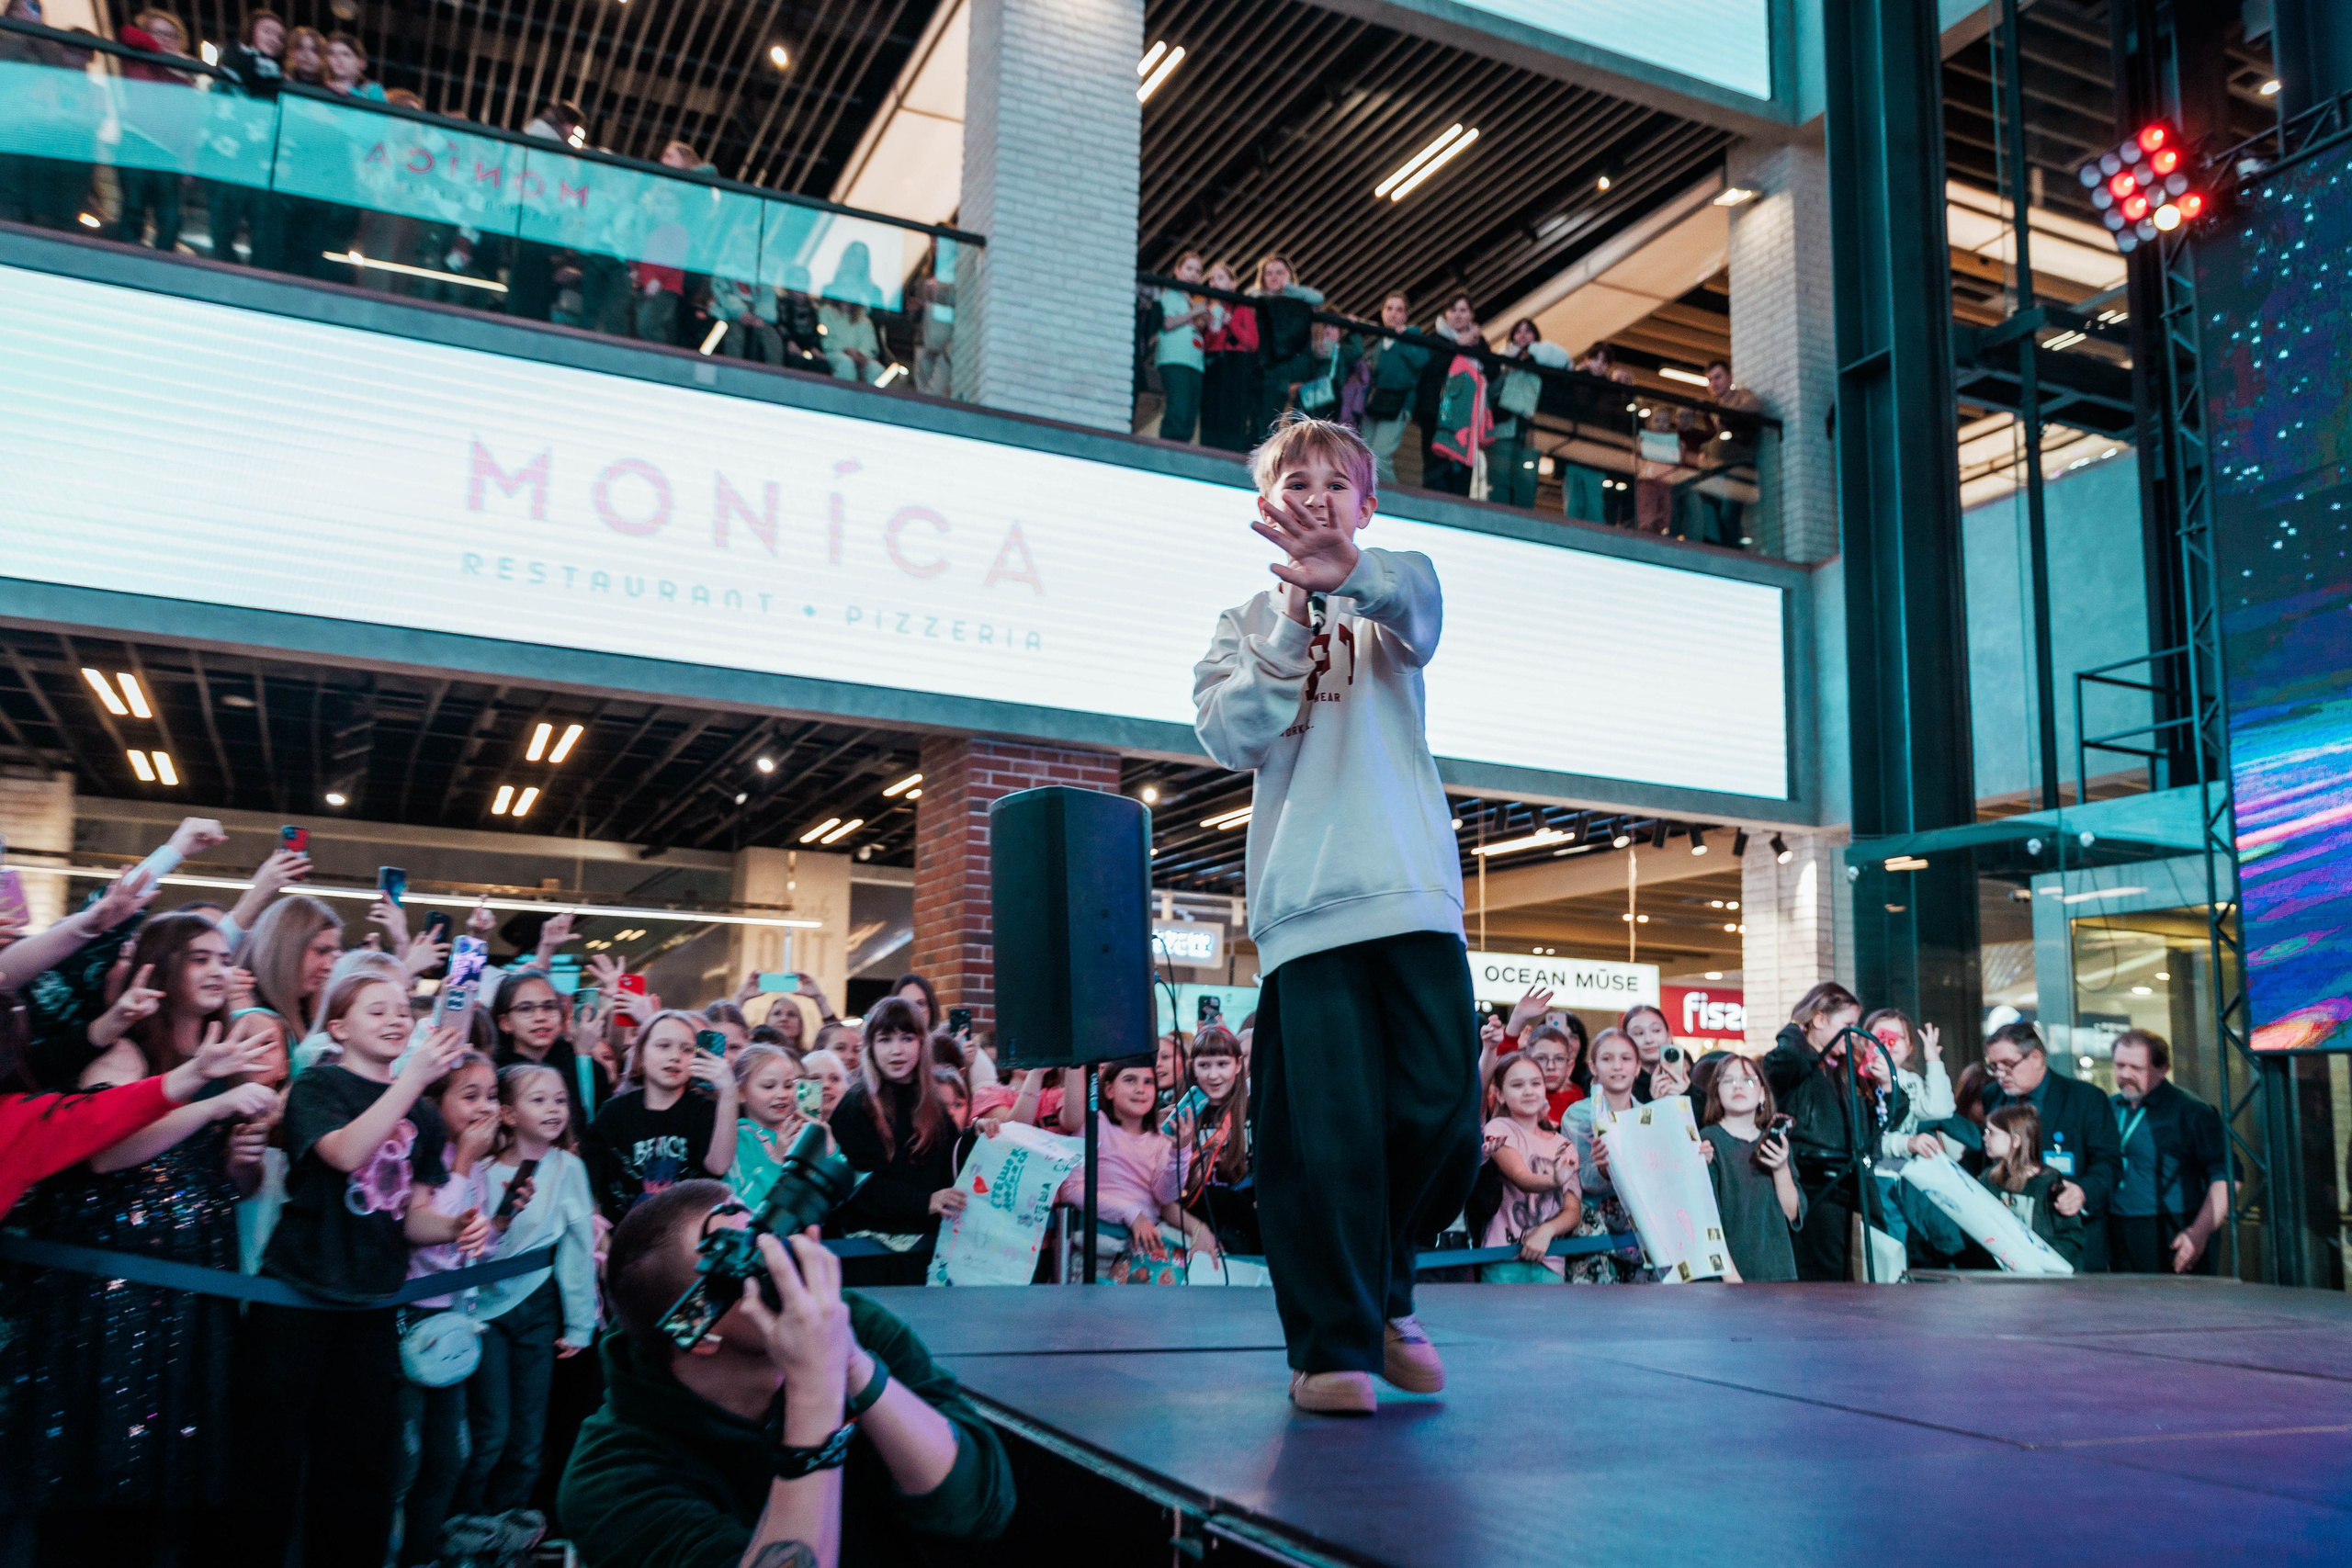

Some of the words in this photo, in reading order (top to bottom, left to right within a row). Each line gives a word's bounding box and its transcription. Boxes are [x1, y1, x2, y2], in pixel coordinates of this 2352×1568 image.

[465, 435, 1046, 596] MONÍCA
[460, 551, 775, 614] RESTAURANT
[844, 604, 1042, 651] PIZZERIA
[1485, 965, 1566, 987] OCEAN
[1576, 968, 1639, 992] MŪSE
